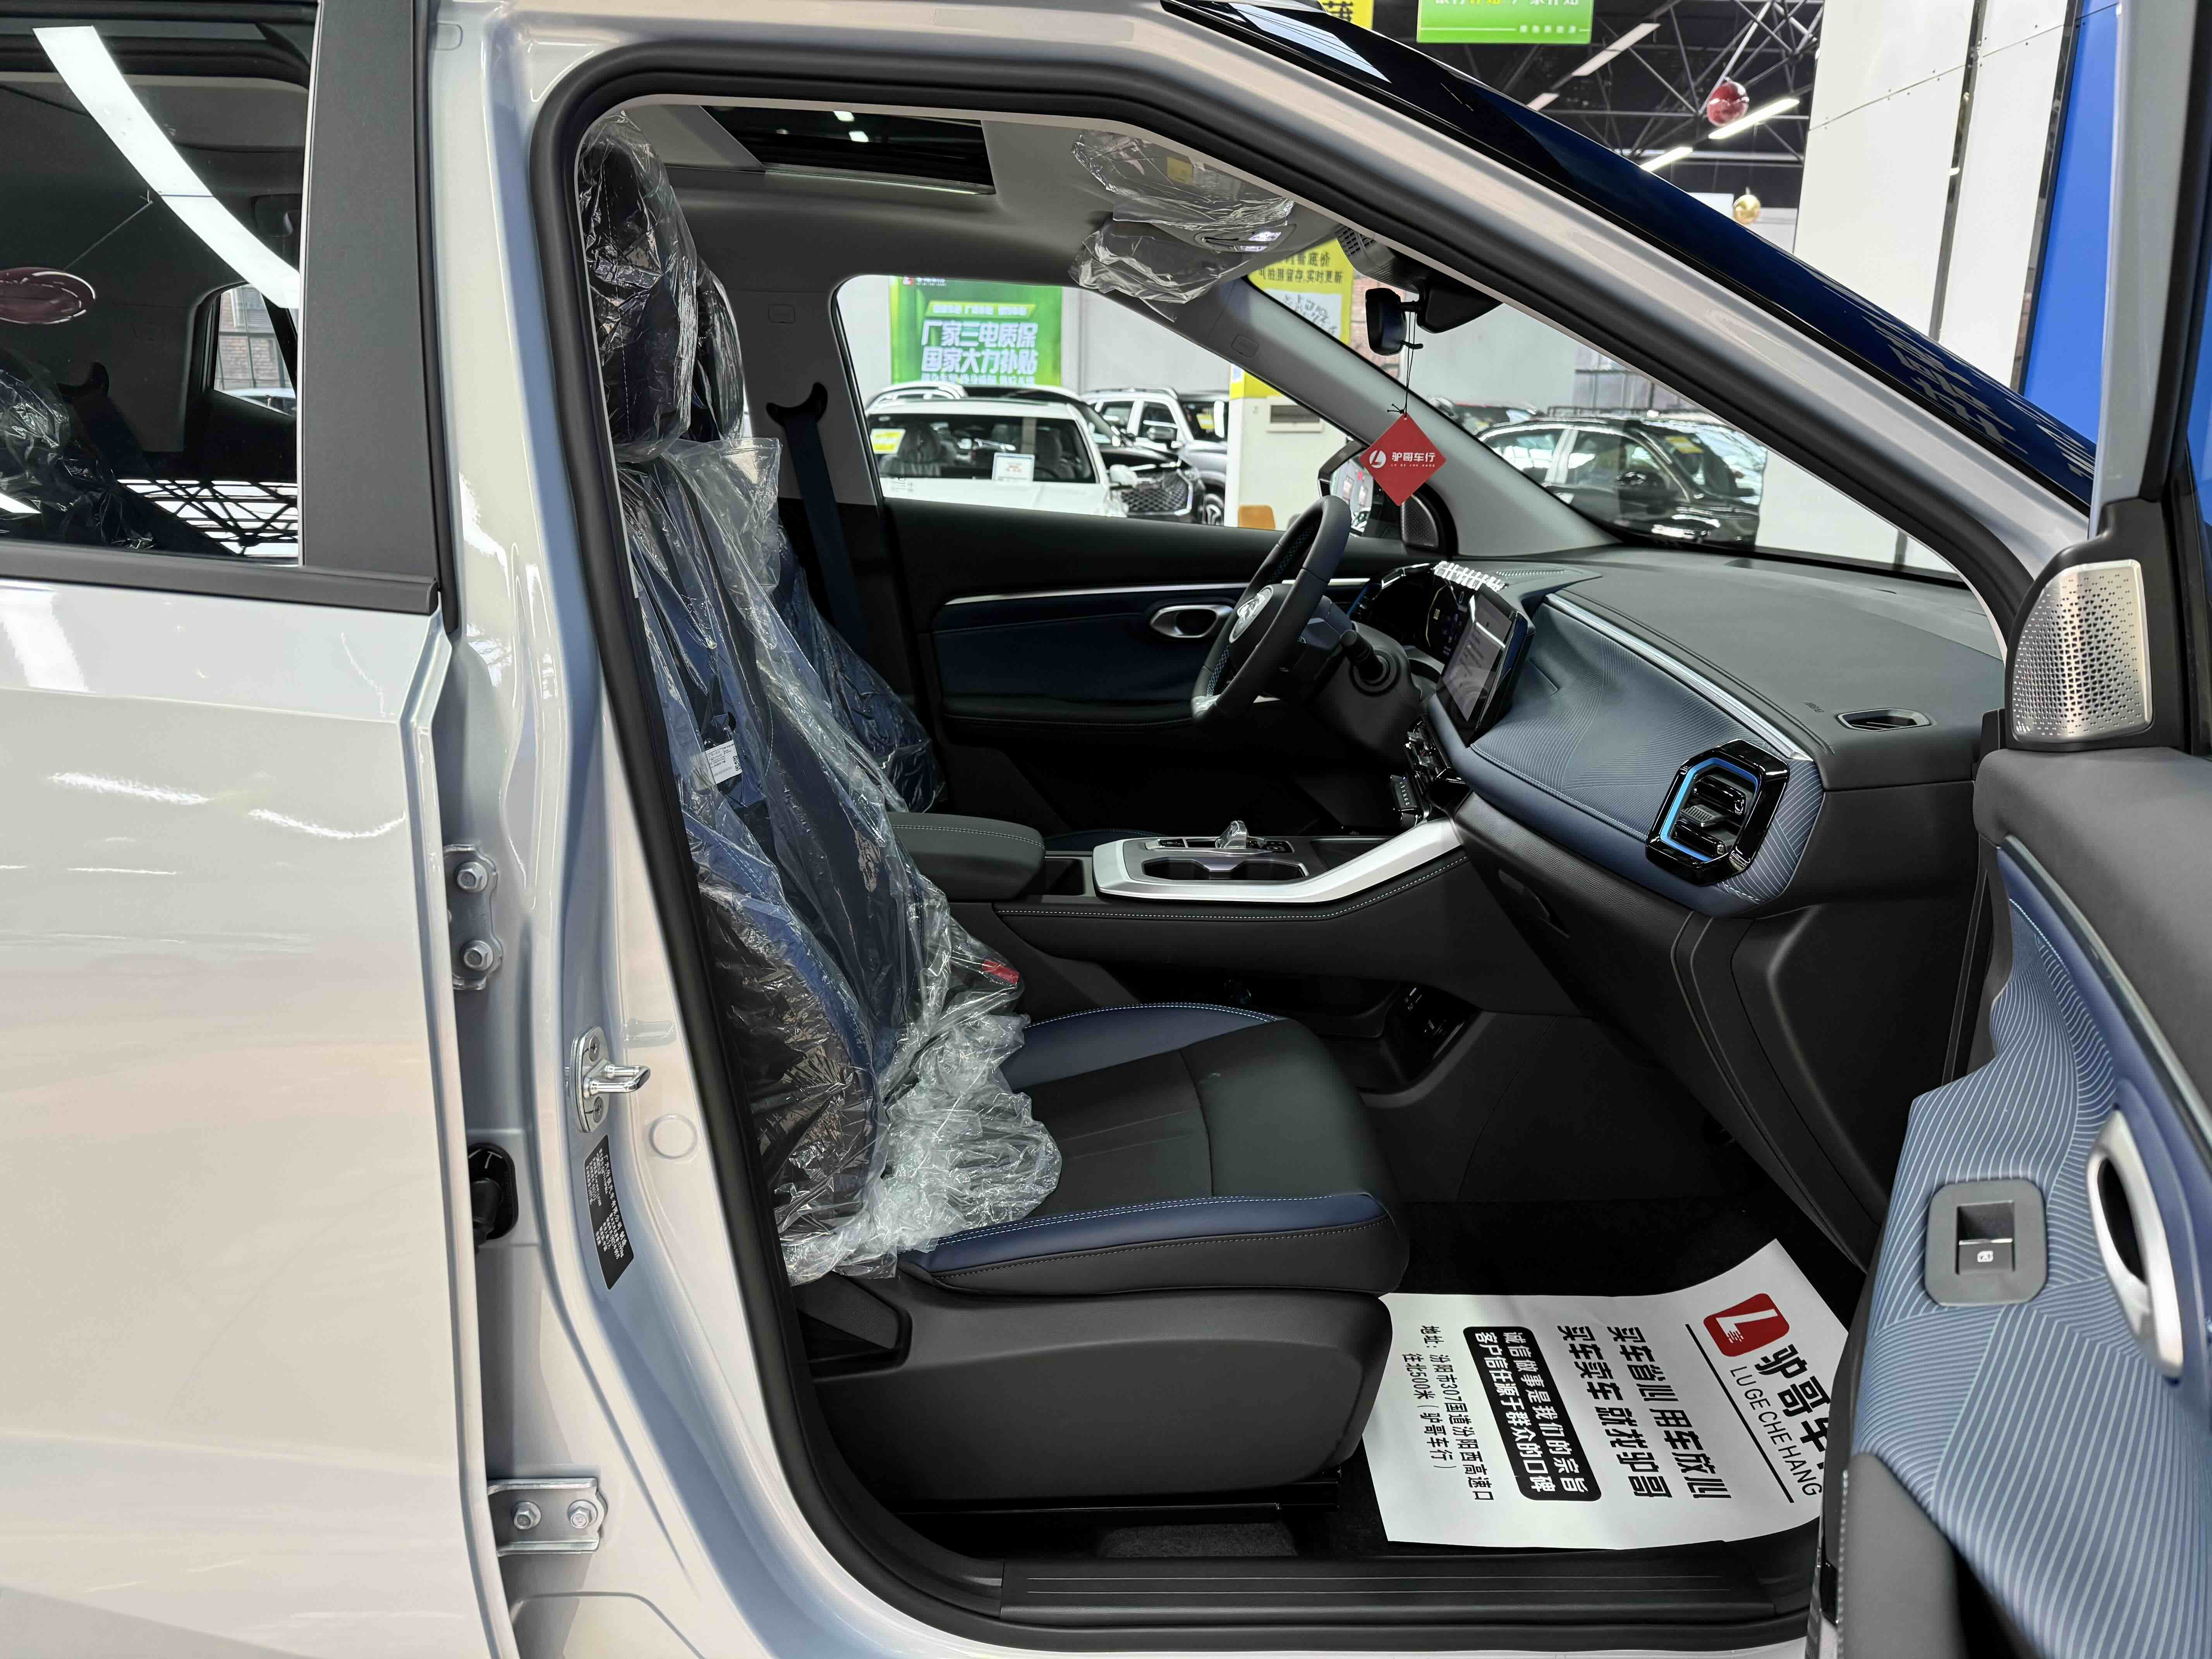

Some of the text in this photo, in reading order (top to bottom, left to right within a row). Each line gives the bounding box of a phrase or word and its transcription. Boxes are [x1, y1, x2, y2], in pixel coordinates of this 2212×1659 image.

[921, 320, 1038, 348] 厂家三电质保
[921, 346, 1039, 375] 国家大力补贴
[1392, 452, 1435, 462] 驴哥车行
[1475, 1332, 1556, 1492] 客户信任源于群众的口碑
[1503, 1332, 1589, 1492] 诚信做事是我们的宗旨
[1557, 1326, 1673, 1498] 买车卖车 就找驴哥
[1607, 1326, 1732, 1499] 买车省心 用车放心
[1730, 1366, 1822, 1496] LU GE CHE HANG
[1754, 1344, 1830, 1470] 驴哥车
